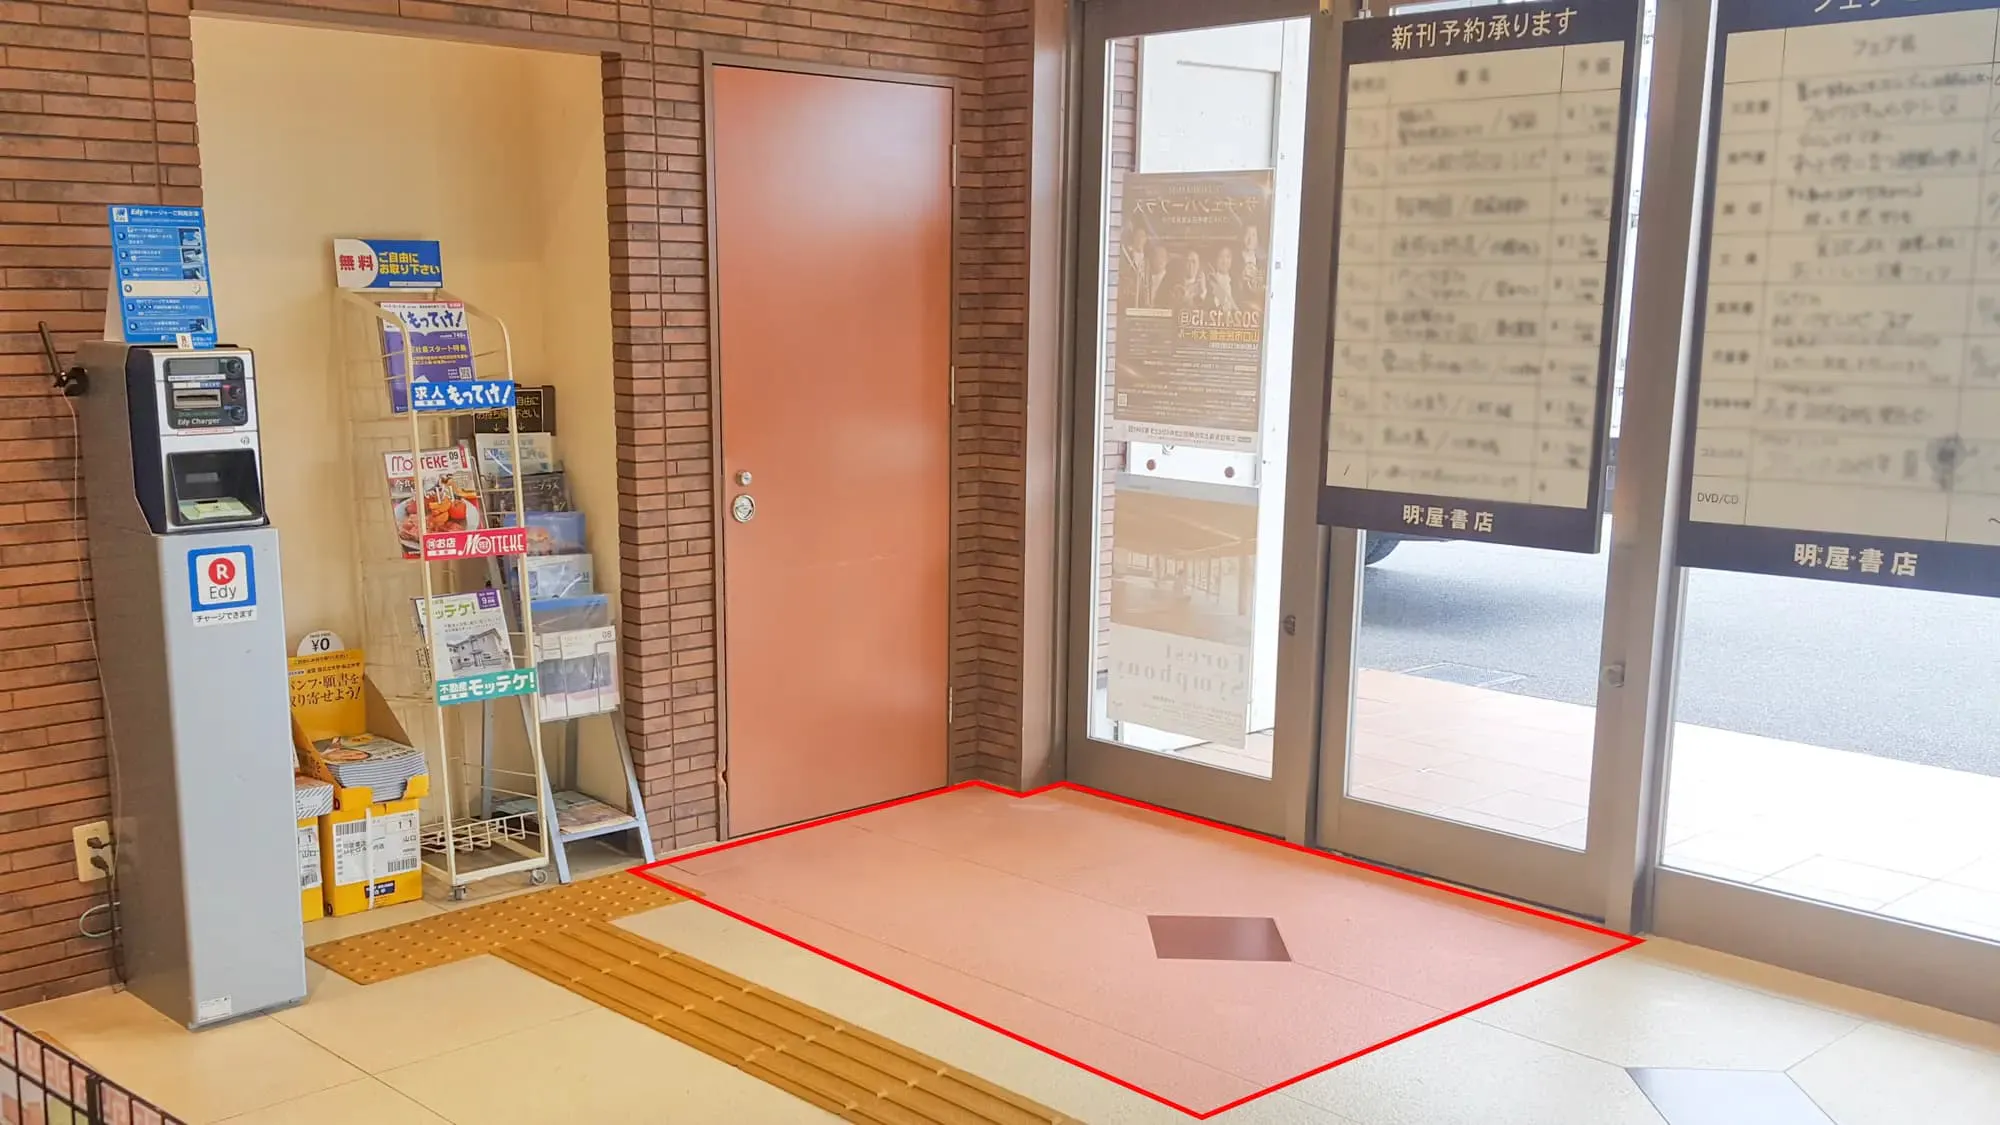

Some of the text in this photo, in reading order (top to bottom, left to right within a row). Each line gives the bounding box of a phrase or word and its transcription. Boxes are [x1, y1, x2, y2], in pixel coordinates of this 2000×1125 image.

[1392, 7, 1577, 51] 新刊予約承ります
[340, 251, 419, 271] 無料 ご自由に
[379, 264, 440, 275] お取り下さい
[407, 310, 462, 328] もってけ!
[414, 383, 512, 405] 求人 もってけ!
[191, 417, 220, 425] Charger
[391, 451, 458, 473] MOTEKE 09
[1697, 492, 1739, 505] DVD/CD
[1403, 504, 1493, 533] 明屋書店
[458, 534, 524, 555] MOTTEKE
[1794, 543, 1918, 577] 明屋書店
[216, 563, 230, 581] R
[209, 585, 237, 600] Edy
[196, 609, 253, 623] チャージできます
[312, 637, 330, 652] ¥0
[440, 671, 535, 696] 不動産 モッテケ!
